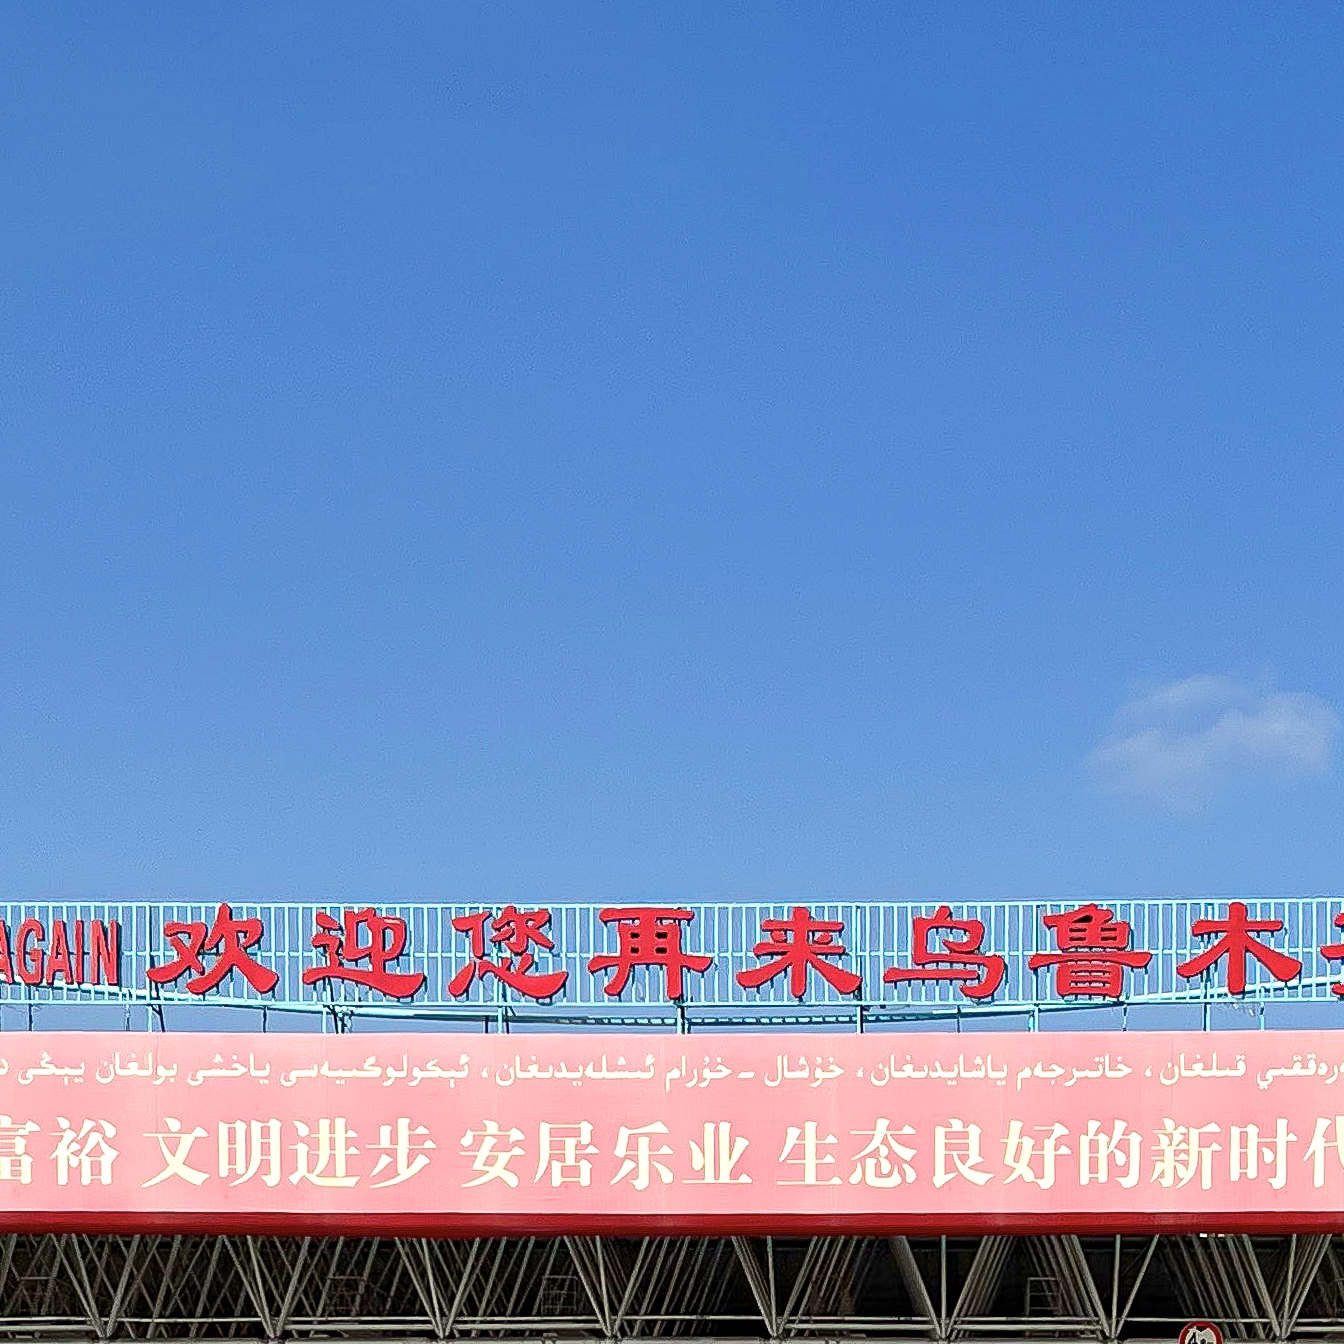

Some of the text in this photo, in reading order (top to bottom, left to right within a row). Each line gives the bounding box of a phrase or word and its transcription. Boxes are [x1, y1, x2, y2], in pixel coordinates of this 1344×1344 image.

[141, 1117, 437, 1190] 文明进步
[459, 1119, 754, 1191] 安居乐业
